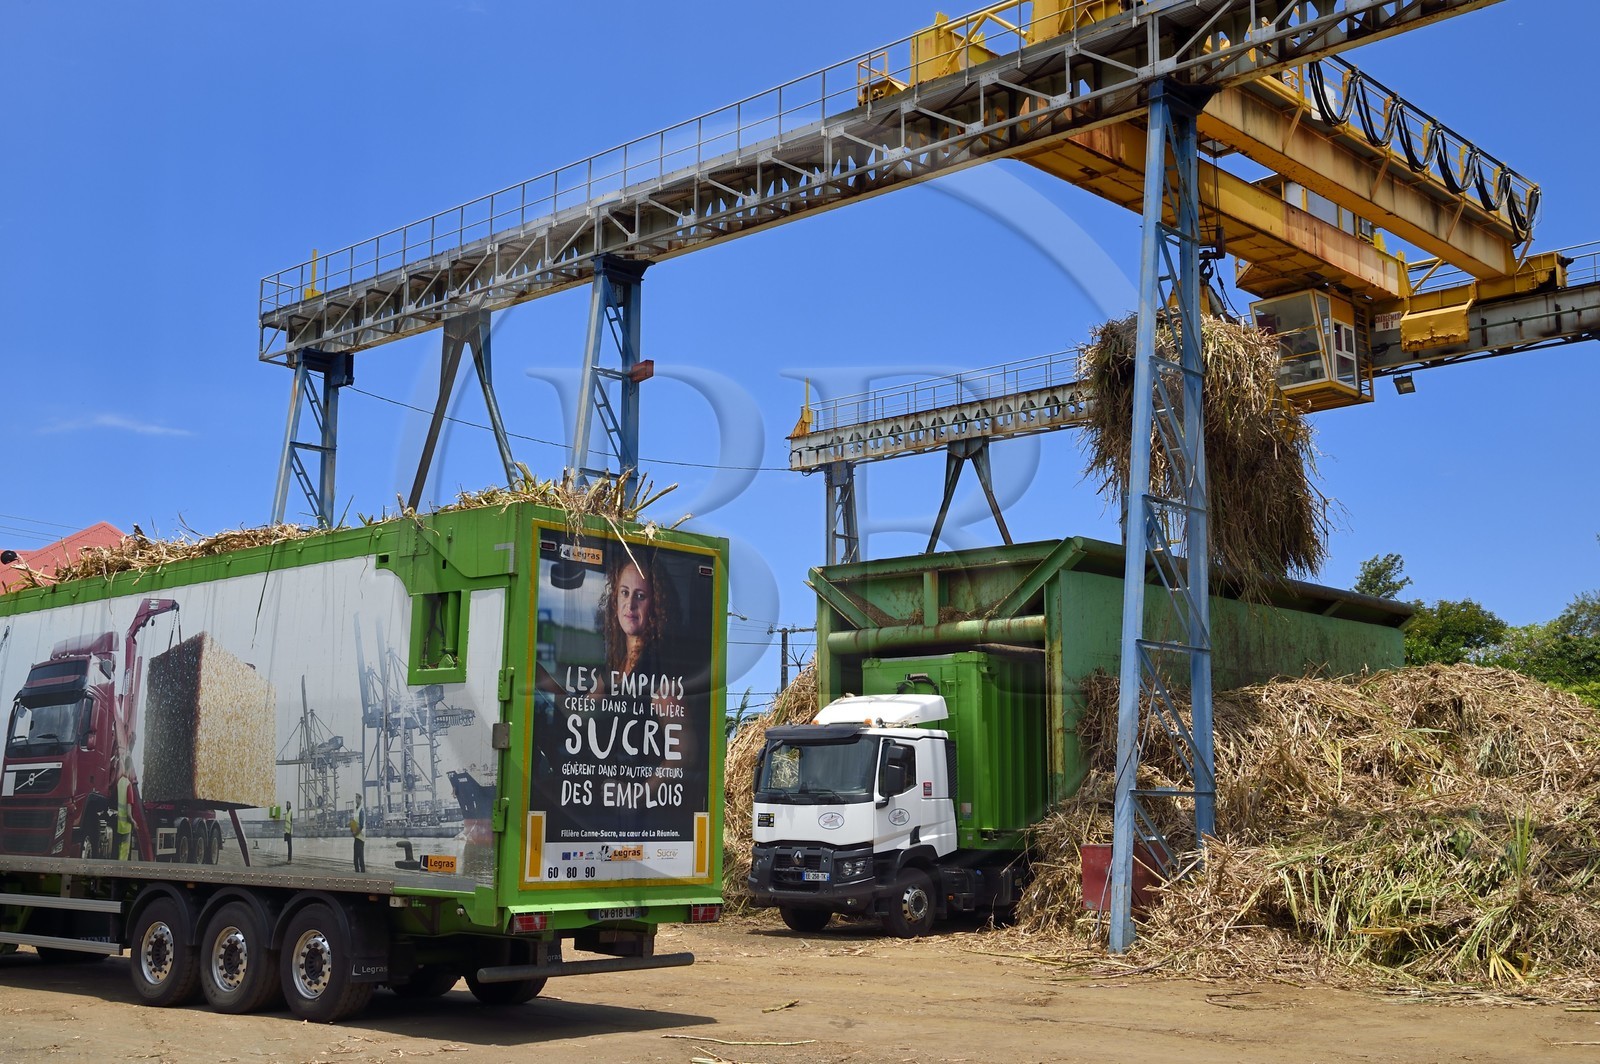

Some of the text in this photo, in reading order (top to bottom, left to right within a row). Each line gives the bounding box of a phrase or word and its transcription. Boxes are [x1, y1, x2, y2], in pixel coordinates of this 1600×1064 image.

[565, 666, 598, 694] LES
[564, 694, 685, 718] CRÉÉS DANS LA FILIÈRE
[565, 713, 682, 760] SUCRE
[562, 761, 684, 778] GÉNÈRENT DANS D'AUTRES SECTEURS
[561, 779, 684, 809] DES EMPLOIS
[560, 829, 579, 837] Filière
[580, 829, 618, 838] Canne-Sucre,
[641, 829, 649, 837] de
[649, 829, 656, 837] La
[656, 829, 680, 837] Réunion.
[613, 848, 641, 858] Legras
[430, 859, 454, 869] Legras
[547, 866, 559, 879] 60
[566, 866, 577, 879] 80
[585, 866, 596, 878] 90
[361, 966, 388, 975] Legras
